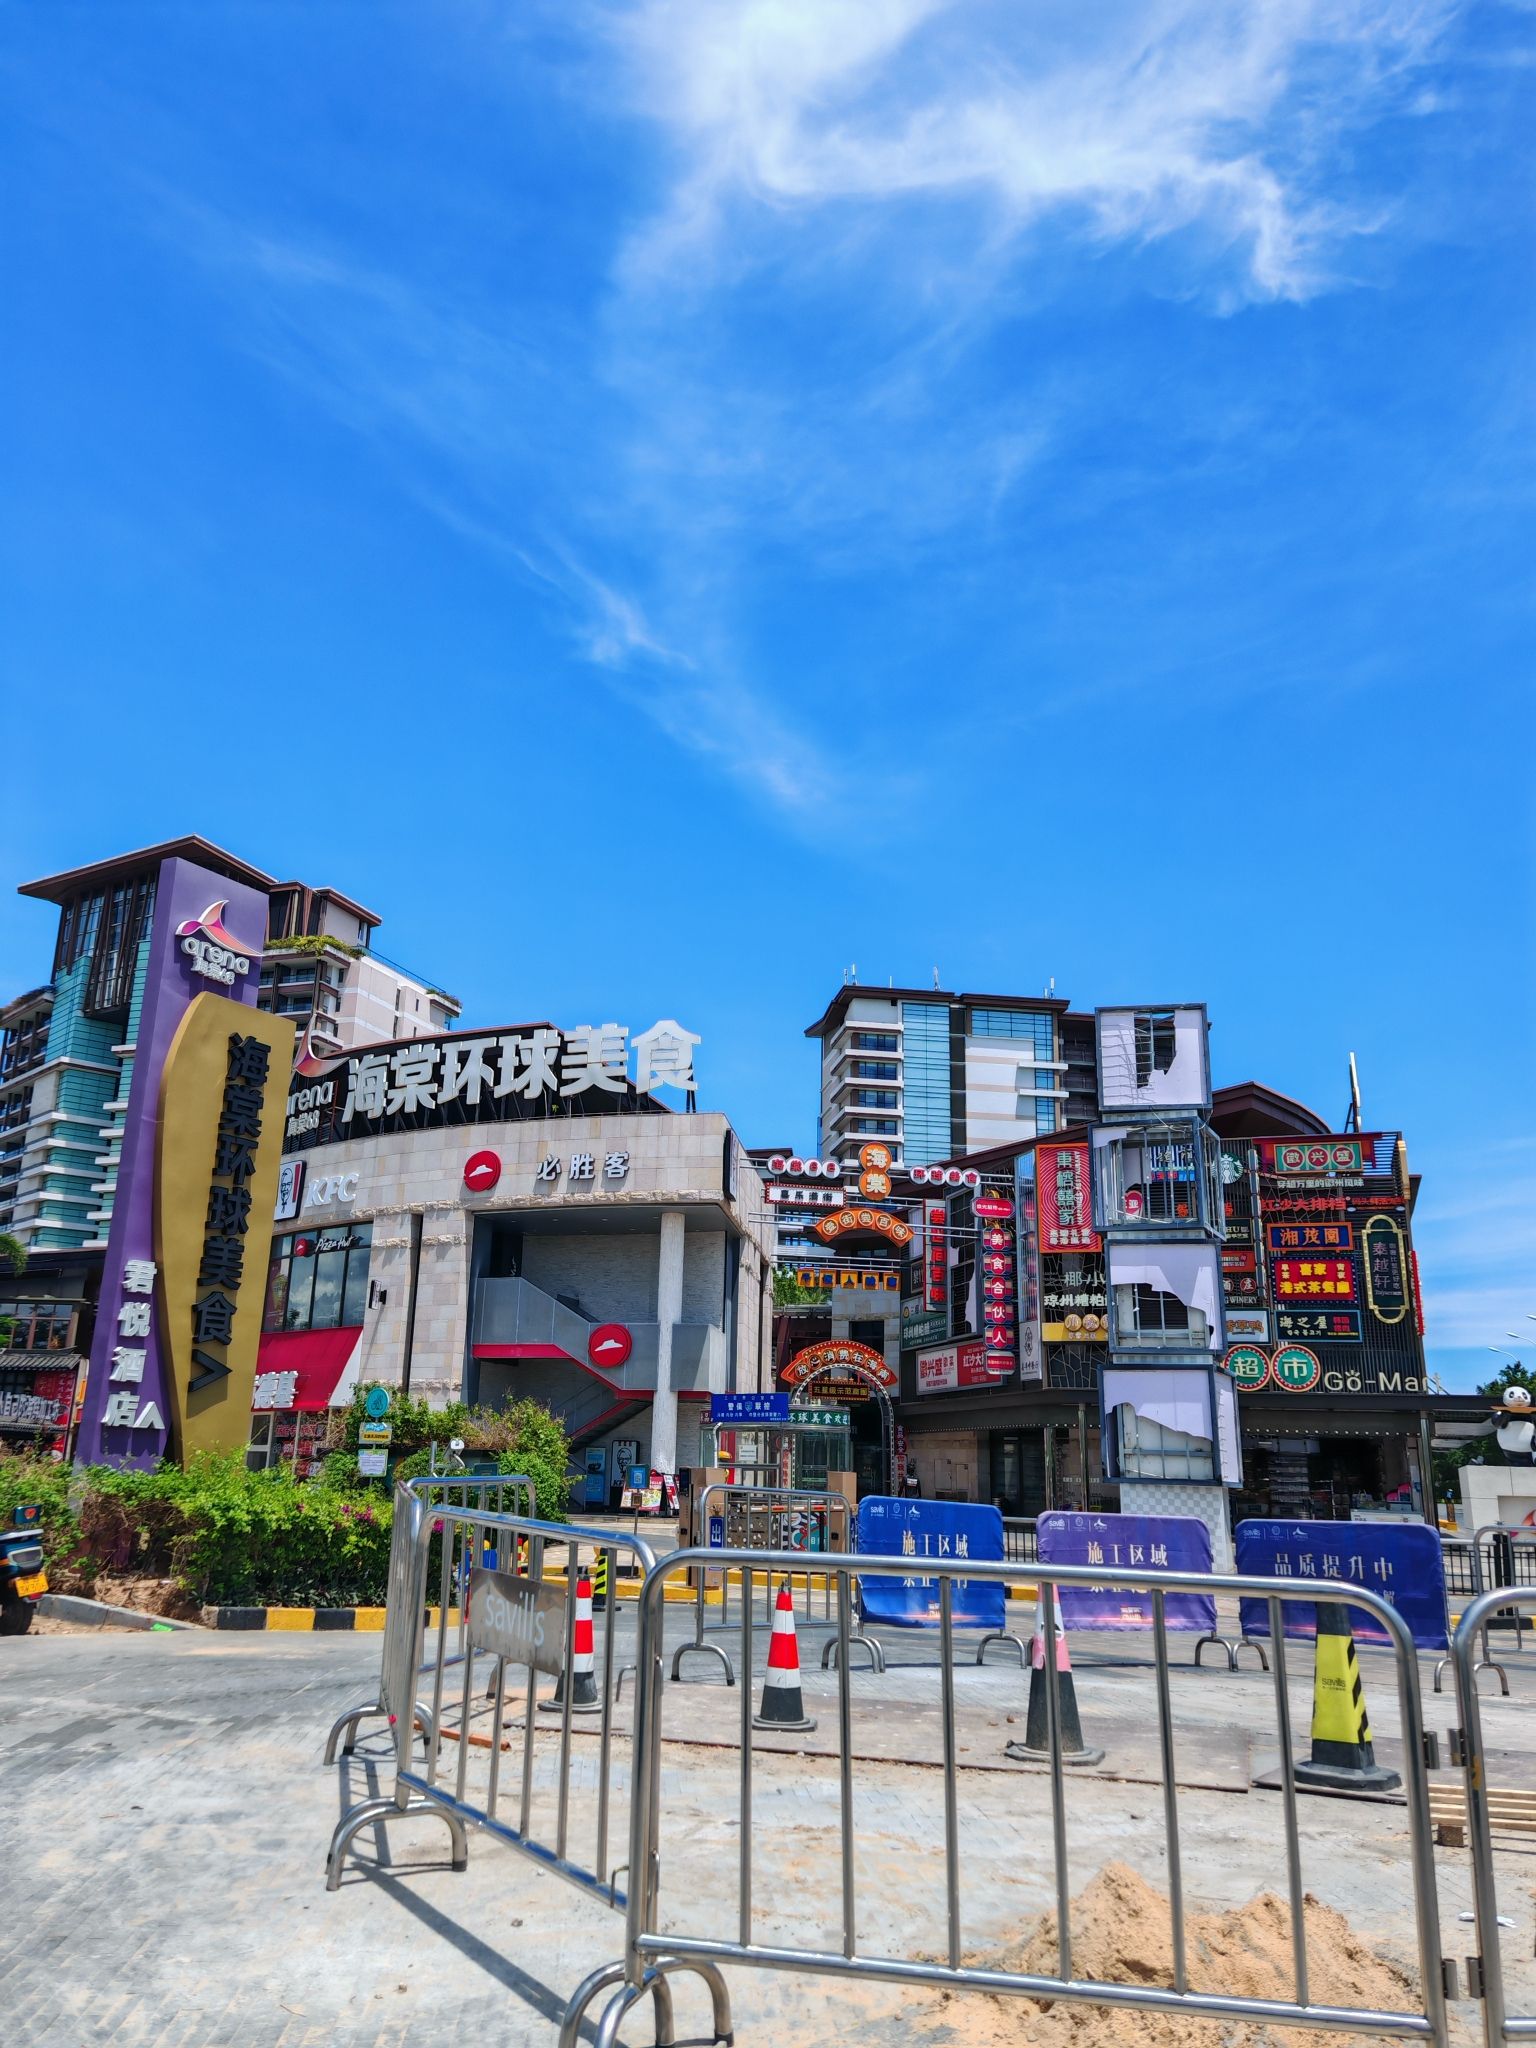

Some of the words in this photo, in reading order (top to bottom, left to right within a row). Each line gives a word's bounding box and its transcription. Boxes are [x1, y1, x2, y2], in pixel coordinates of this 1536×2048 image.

[181, 936, 249, 975] arena
[191, 956, 235, 985] 海棠68
[341, 1019, 701, 1123] 海棠环球美食
[537, 1151, 630, 1183] 必胜客
[866, 1149, 887, 1194] 海棠
[913, 1169, 978, 1183] 环球美食
[192, 1032, 271, 1346] 海棠环球美食
[304, 1172, 360, 1208] KFC
[315, 1238, 337, 1253] Pizza
[338, 1234, 357, 1250] Hut
[989, 1233, 1007, 1343] 美食合伙人
[1230, 1296, 1258, 1304] WINERY
[101, 1260, 157, 1428] 君悦酒店
[798, 1348, 890, 1380] 放心消费在海南
[1234, 1357, 1308, 1379] 超市
[871, 1505, 885, 1513] savills
[902, 1529, 969, 1558] 施工区域
[1088, 1541, 1168, 1567] 施工区域
[1274, 1552, 1393, 1582] 品质提升中
[485, 1591, 545, 1647] savills
[1321, 1677, 1347, 1687] savills
